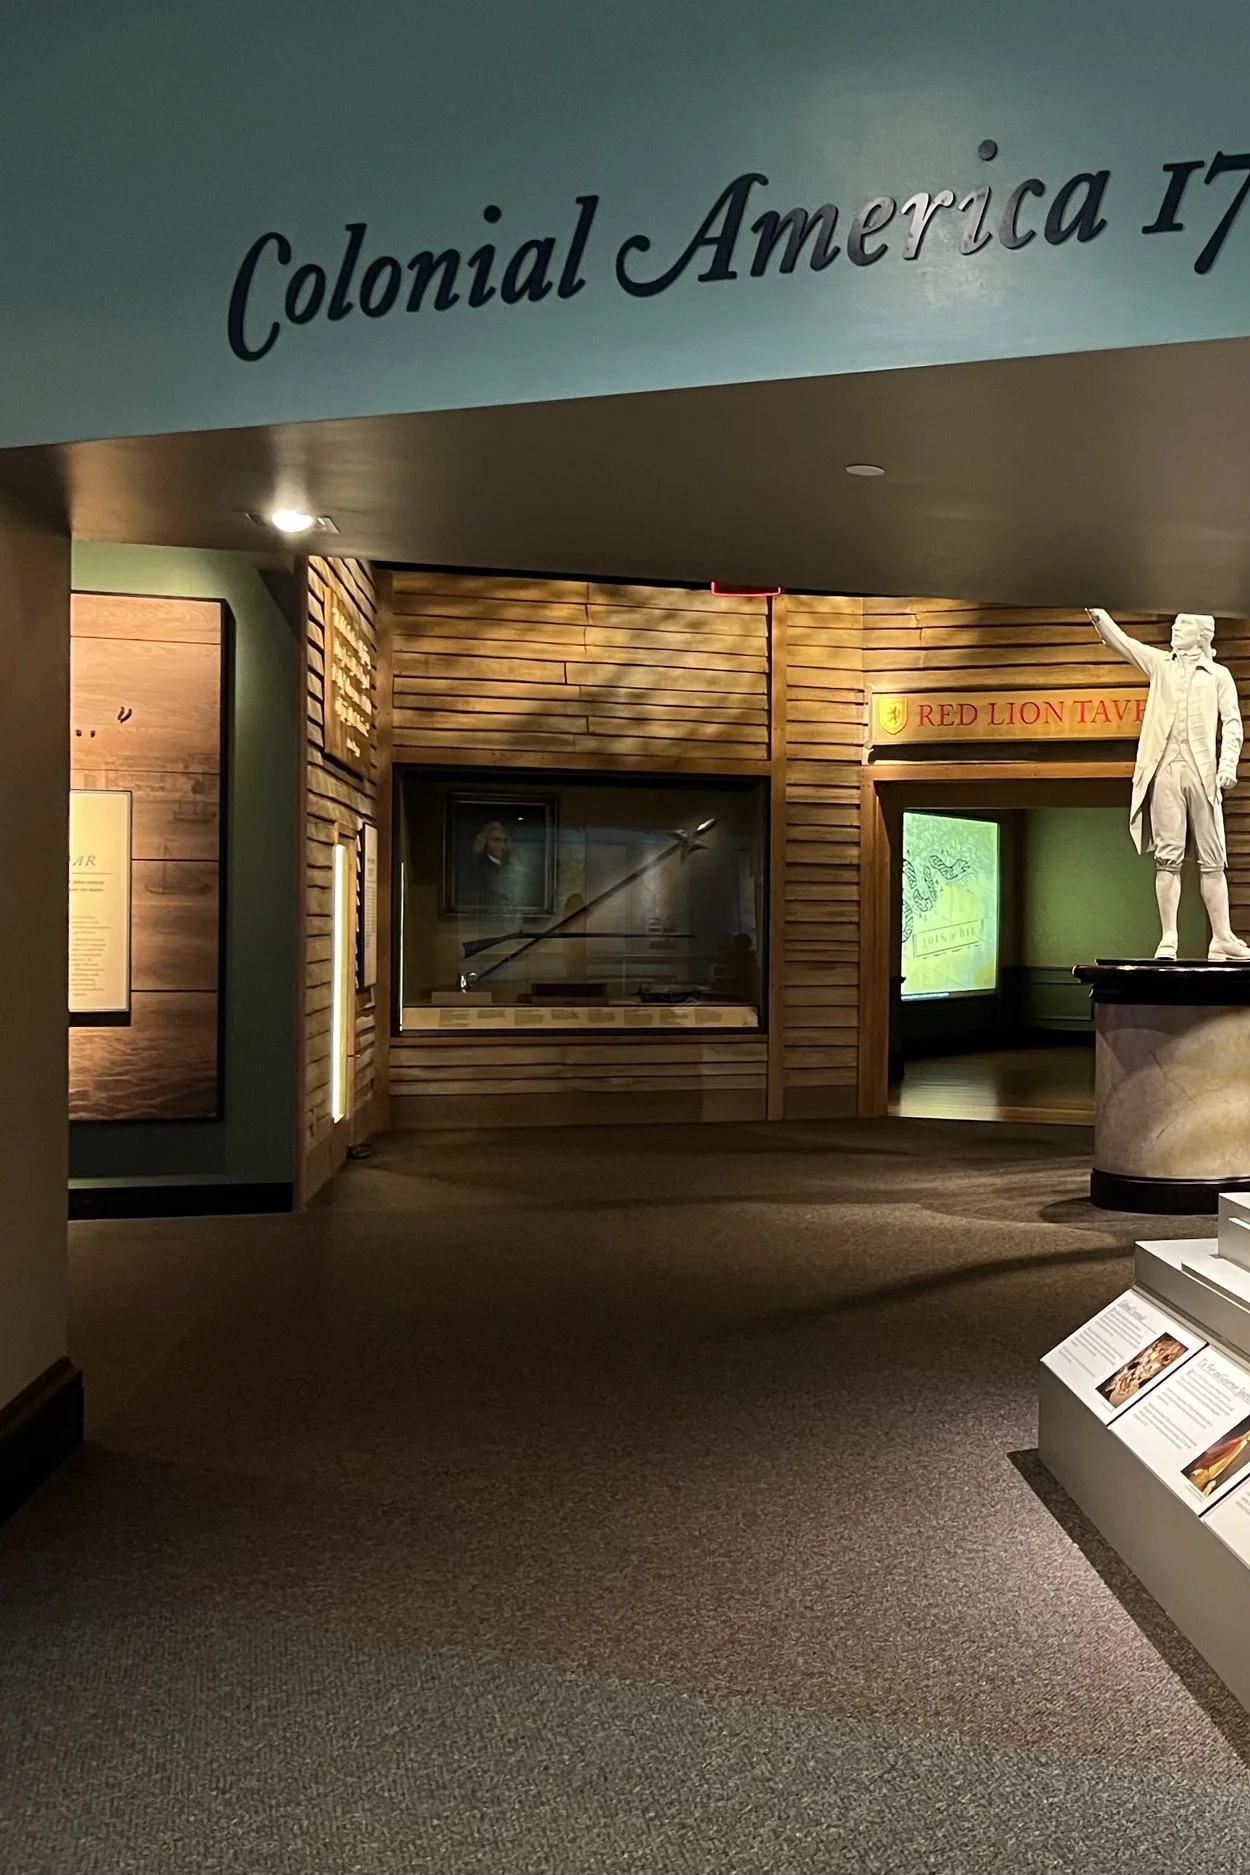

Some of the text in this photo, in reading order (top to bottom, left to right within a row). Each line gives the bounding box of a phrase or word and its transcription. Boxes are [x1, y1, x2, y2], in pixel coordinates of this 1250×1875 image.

[227, 193, 599, 363] Colonial
[615, 138, 1111, 298] America
[917, 703, 979, 728] RED
[986, 701, 1065, 726] LION
[69, 855, 96, 866] AR
